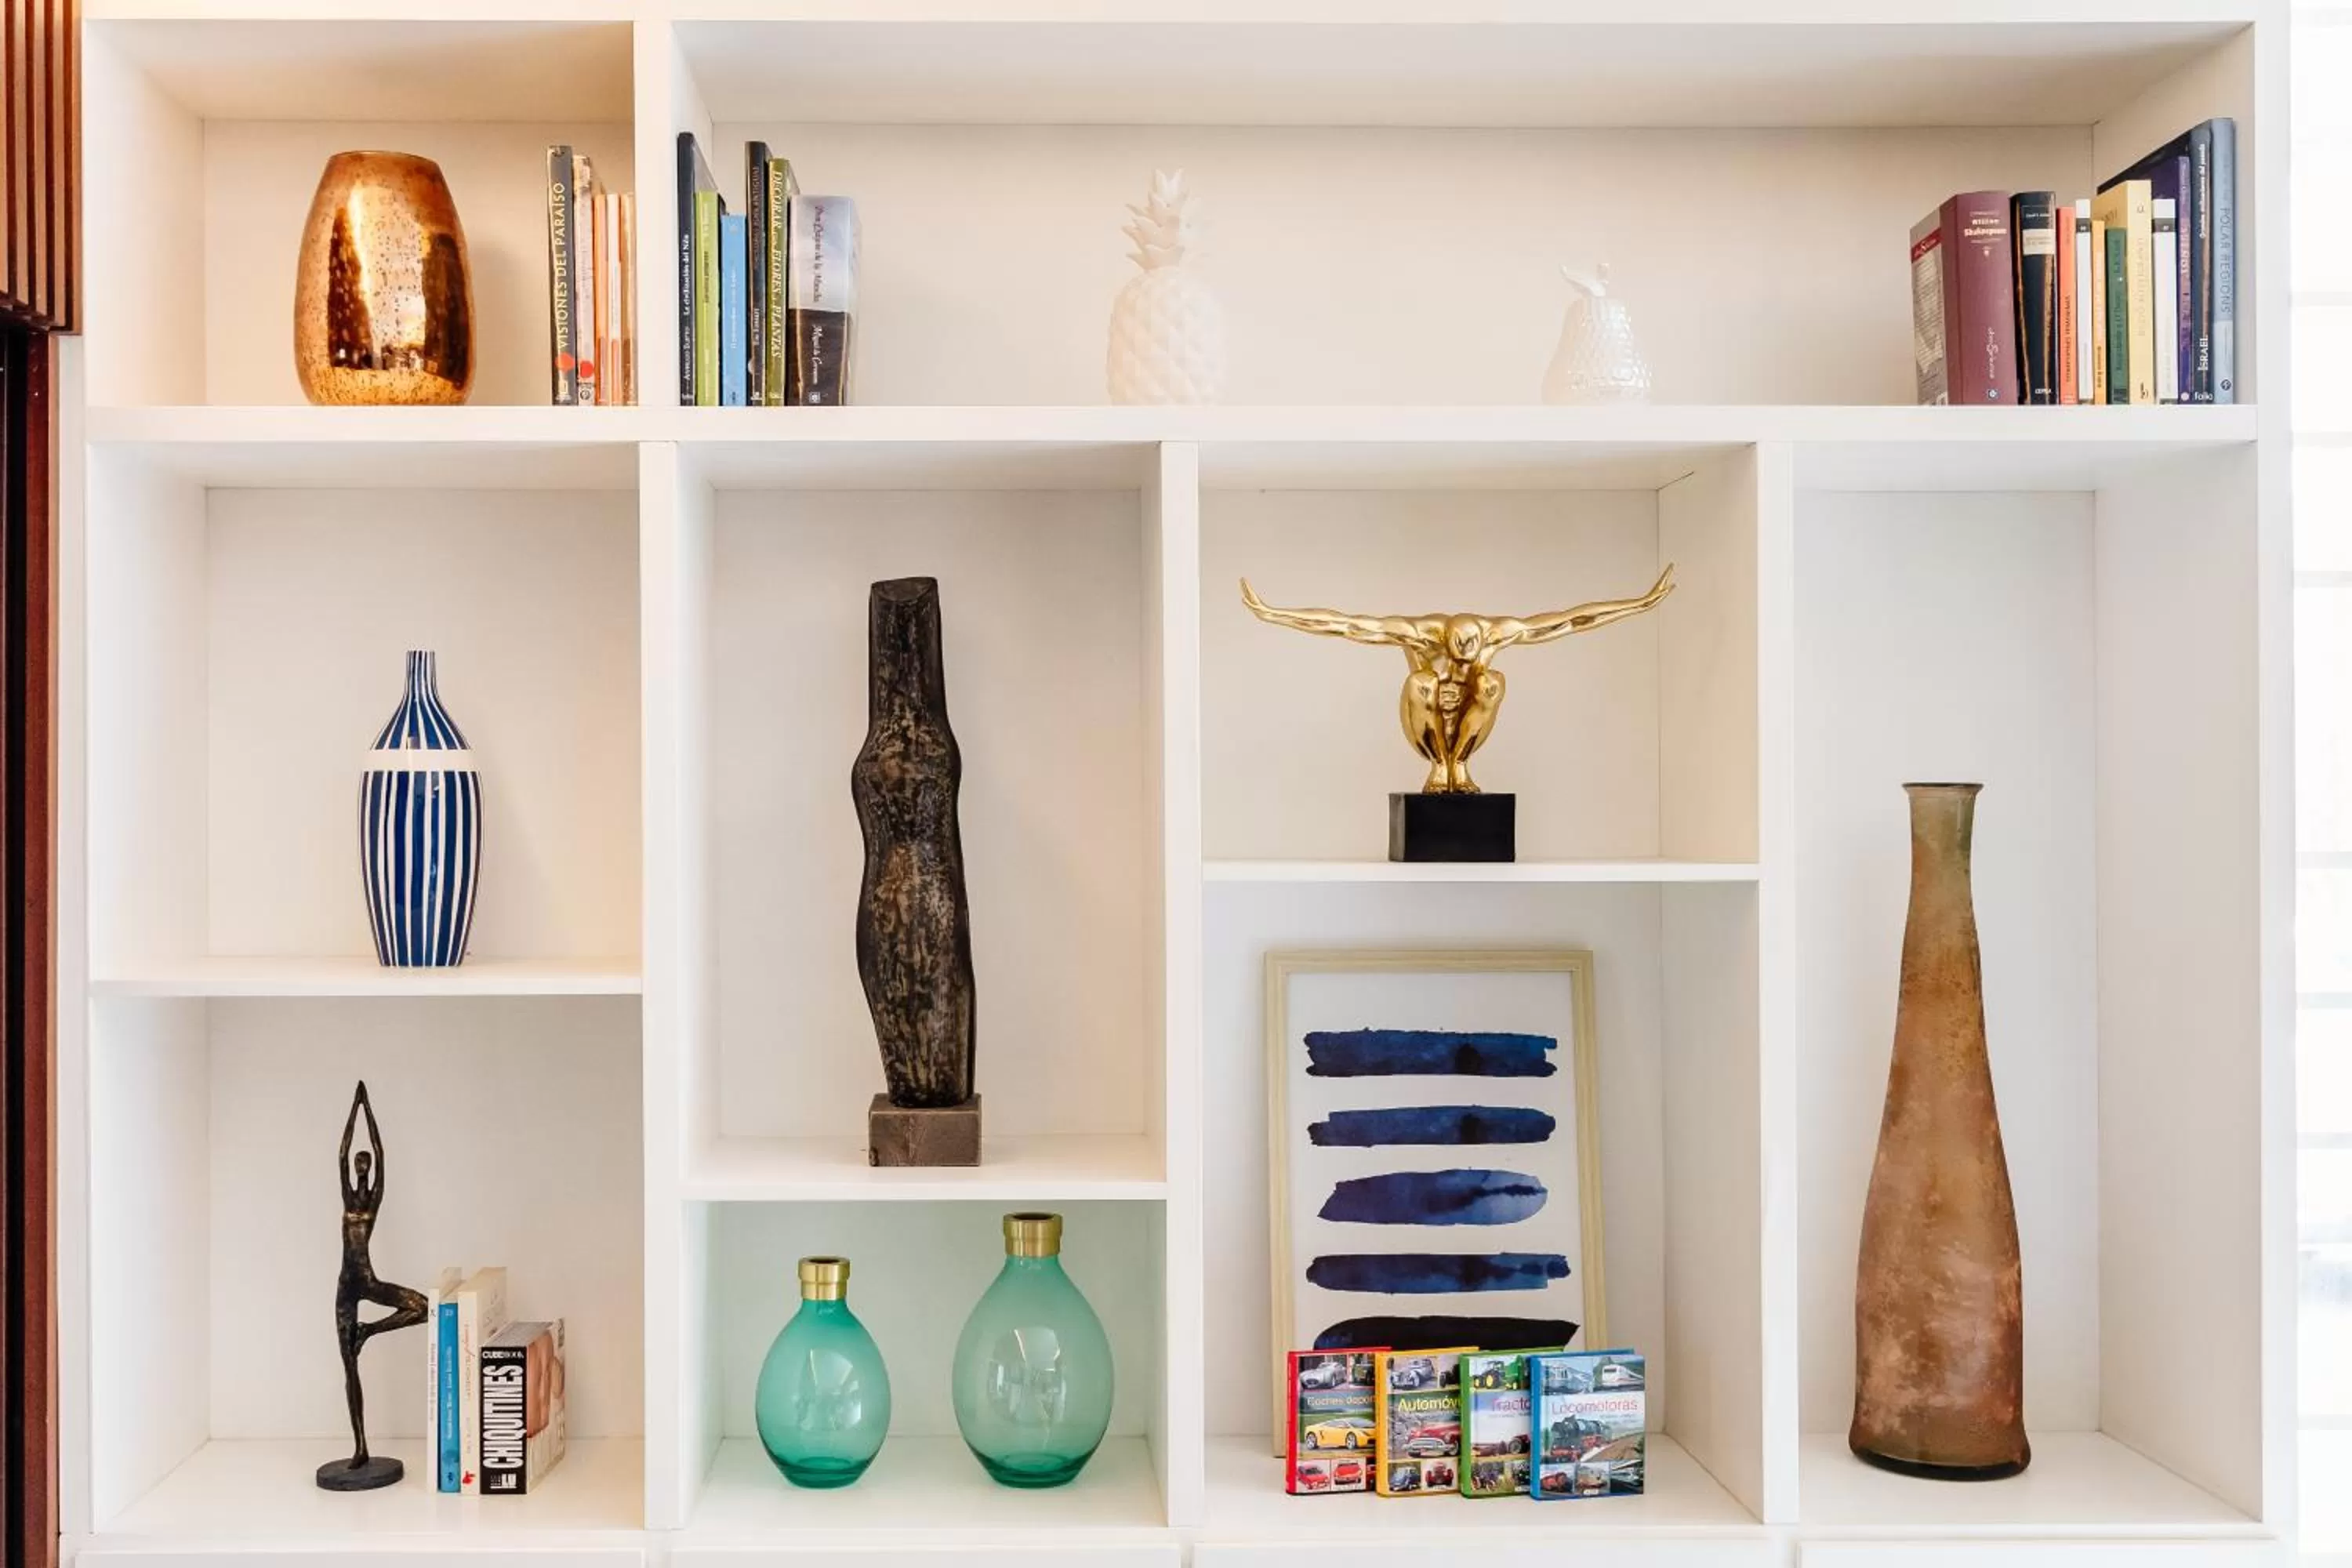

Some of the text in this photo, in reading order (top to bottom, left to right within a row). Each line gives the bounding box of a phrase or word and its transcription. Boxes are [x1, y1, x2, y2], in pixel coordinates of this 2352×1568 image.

[771, 170, 782, 229] DECORAR
[2220, 207, 2231, 249] POLAR
[552, 182, 569, 348] VISIONES DEL PARAÍSO
[771, 249, 782, 294] FLORES
[2220, 253, 2231, 314] REGIONS
[771, 305, 782, 358] PLANTAS
[2197, 334, 2209, 371] ISRAEL
[482, 1365, 526, 1468] CHIQUITINES
[1552, 1399, 1639, 1415] Locomotoras
